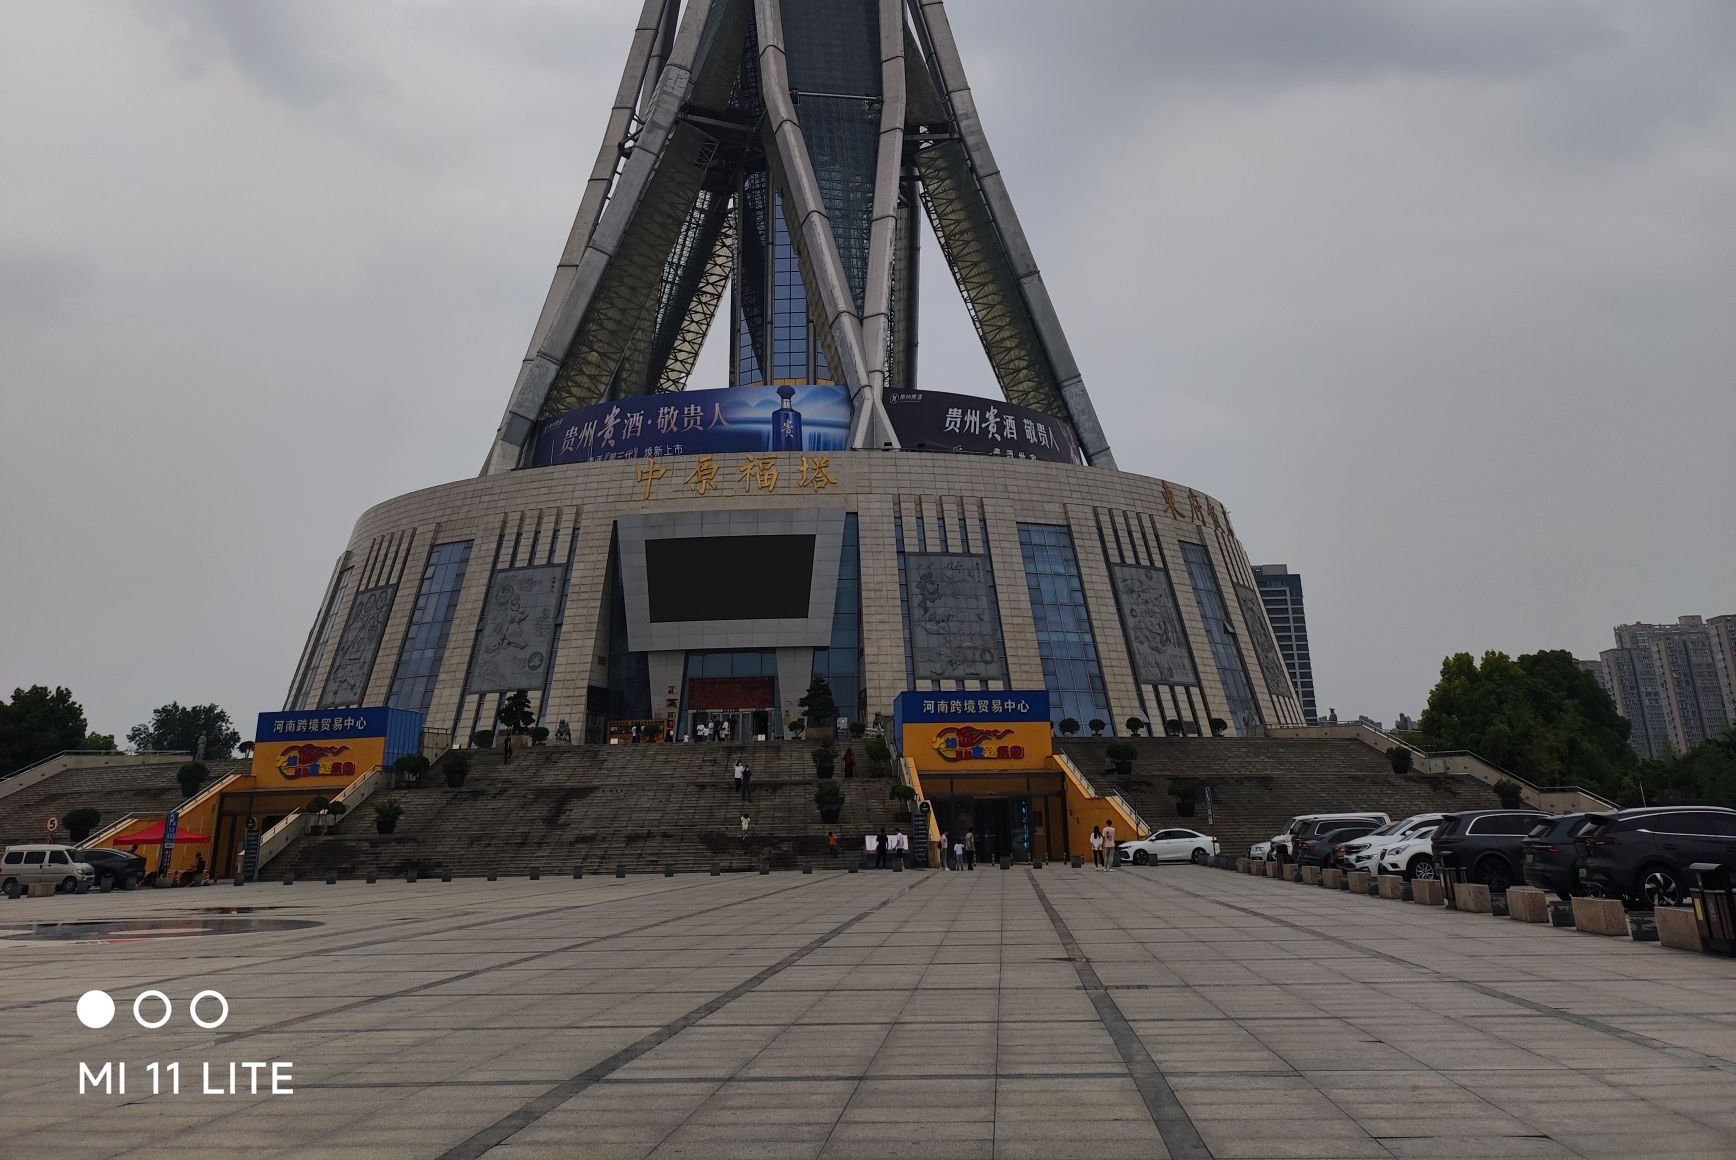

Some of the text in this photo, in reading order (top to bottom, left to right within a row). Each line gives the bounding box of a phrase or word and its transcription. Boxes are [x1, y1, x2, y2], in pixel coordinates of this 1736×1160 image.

[636, 454, 838, 500] 中原福塔
[921, 698, 1030, 714] 河南跨境贸易中心
[272, 716, 367, 734] 河南跨境贸易中心
[48, 818, 56, 829] 5
